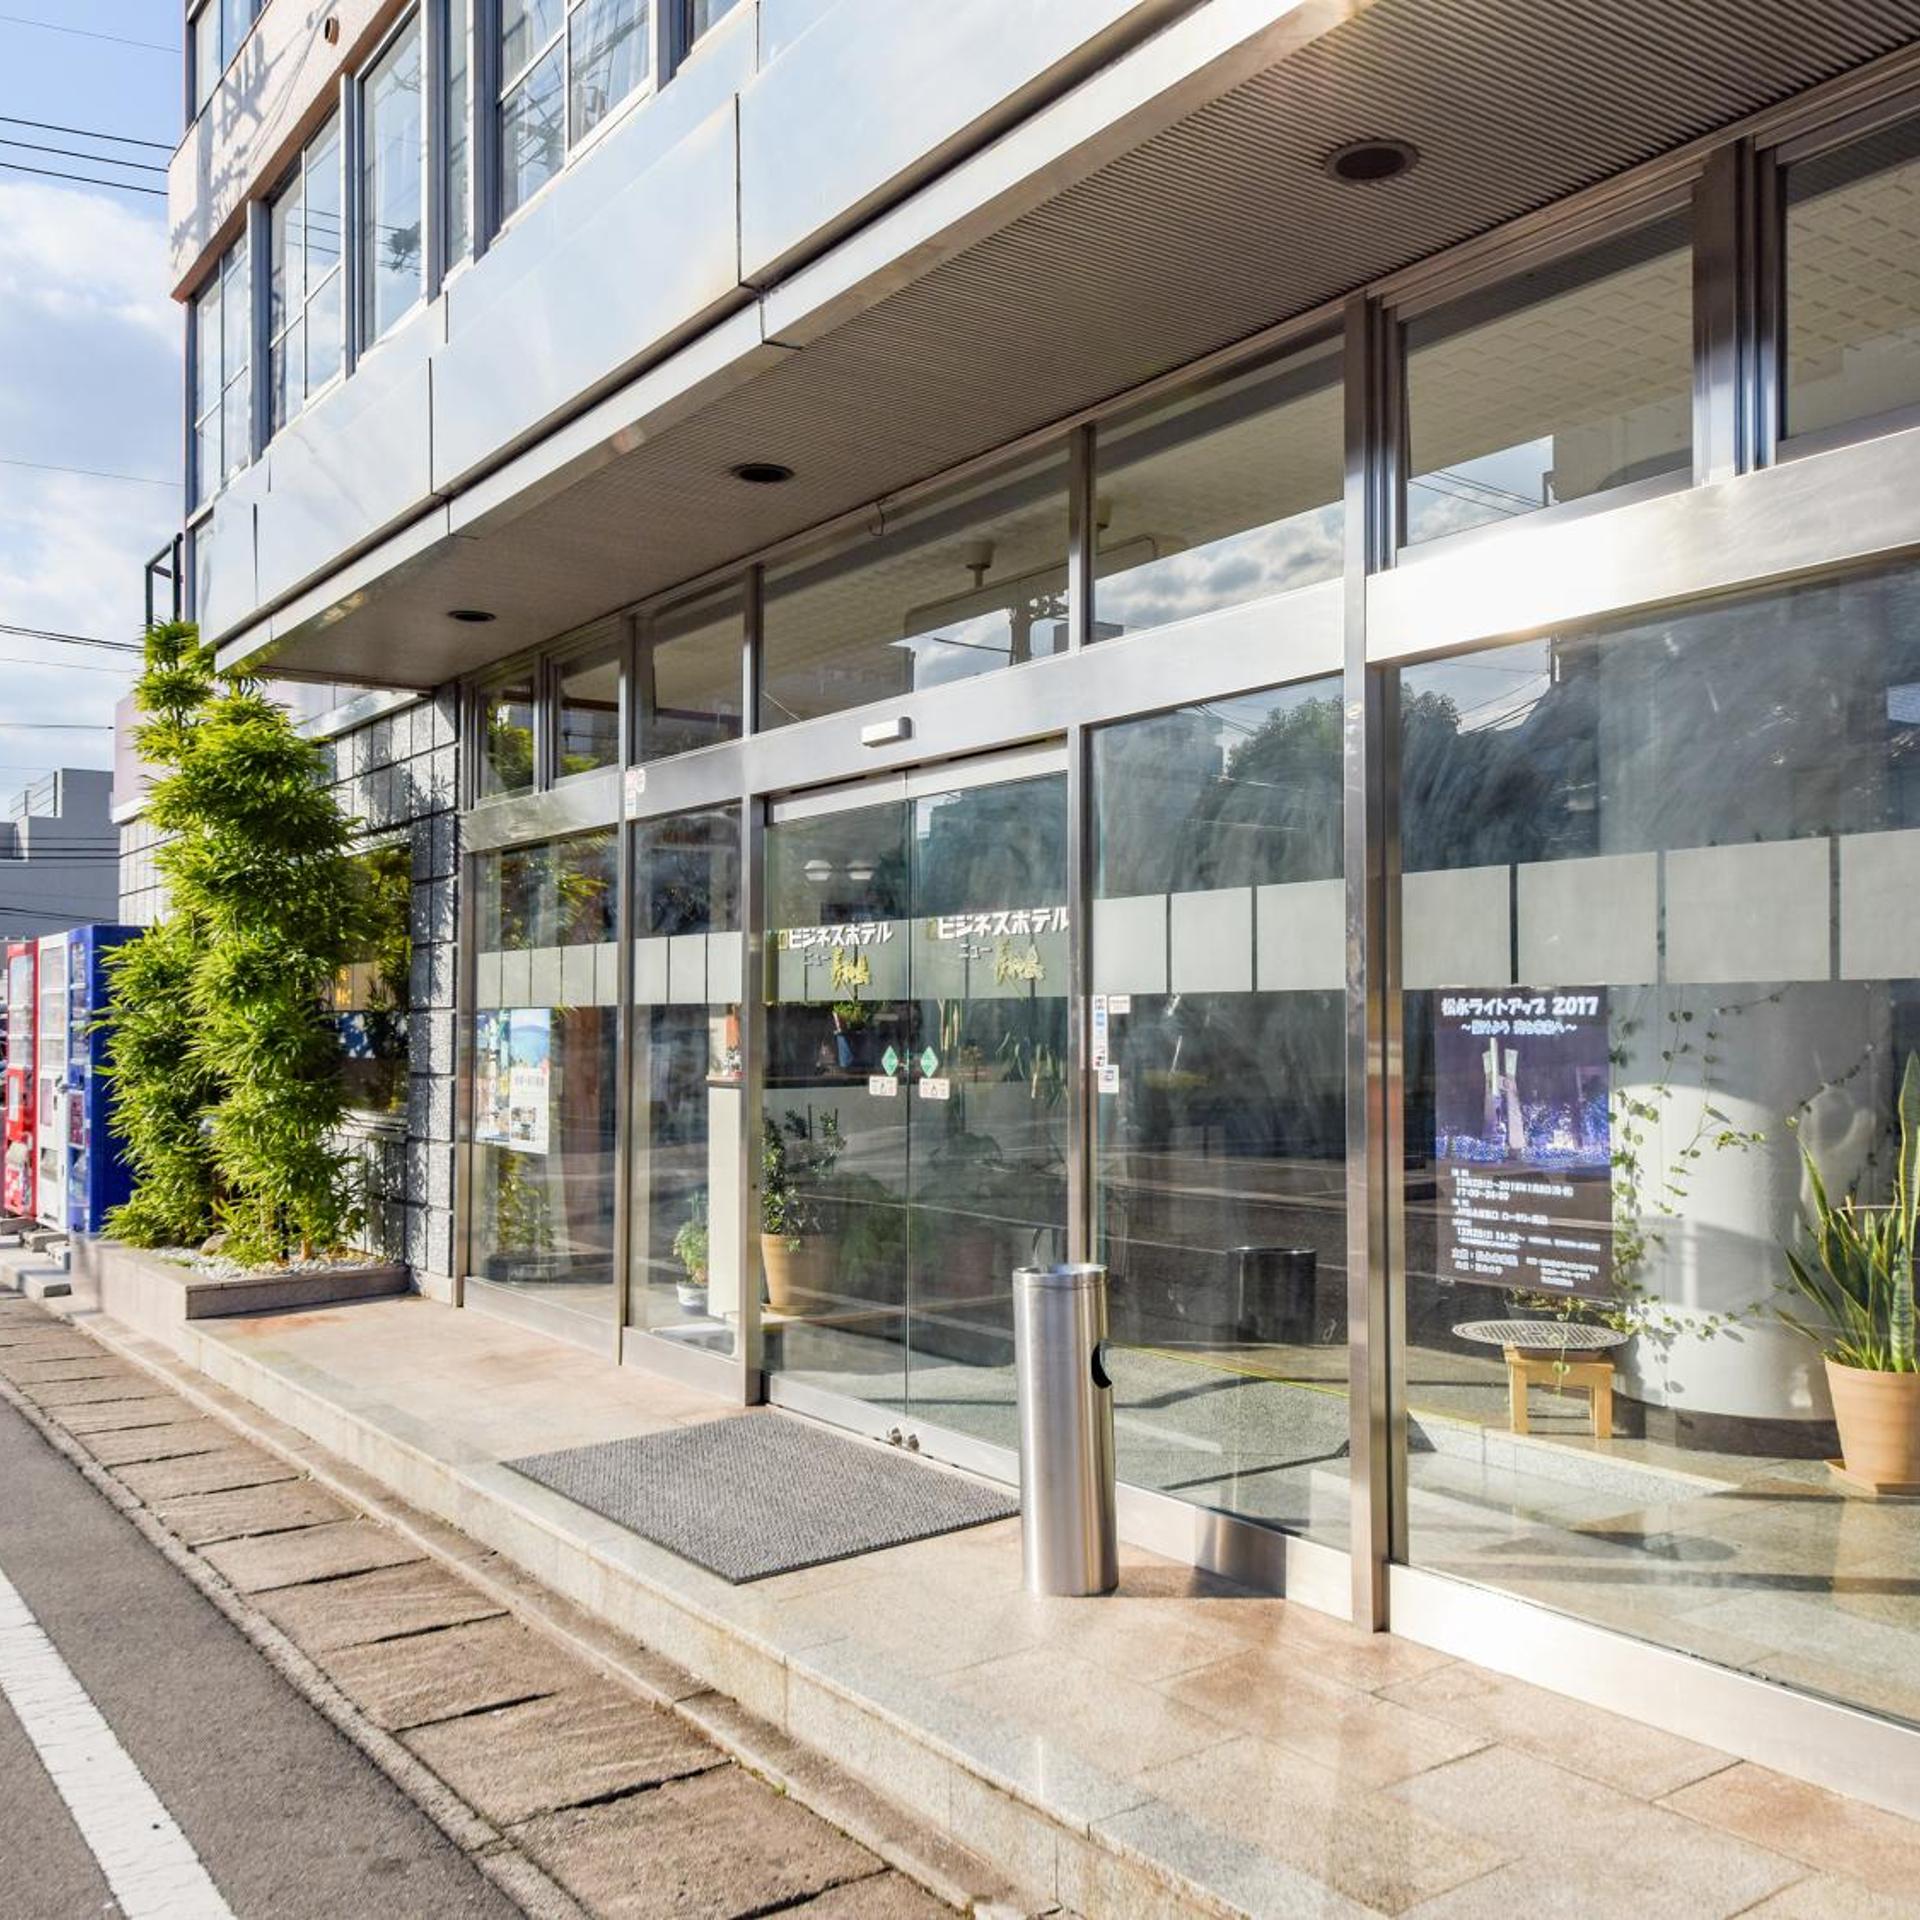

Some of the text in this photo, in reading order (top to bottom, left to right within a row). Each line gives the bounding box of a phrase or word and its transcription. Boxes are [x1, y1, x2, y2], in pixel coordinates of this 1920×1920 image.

[789, 921, 894, 949] ビジネスホテル
[937, 907, 1070, 940] ビジネスホテル
[1552, 996, 1599, 1016] 2017
